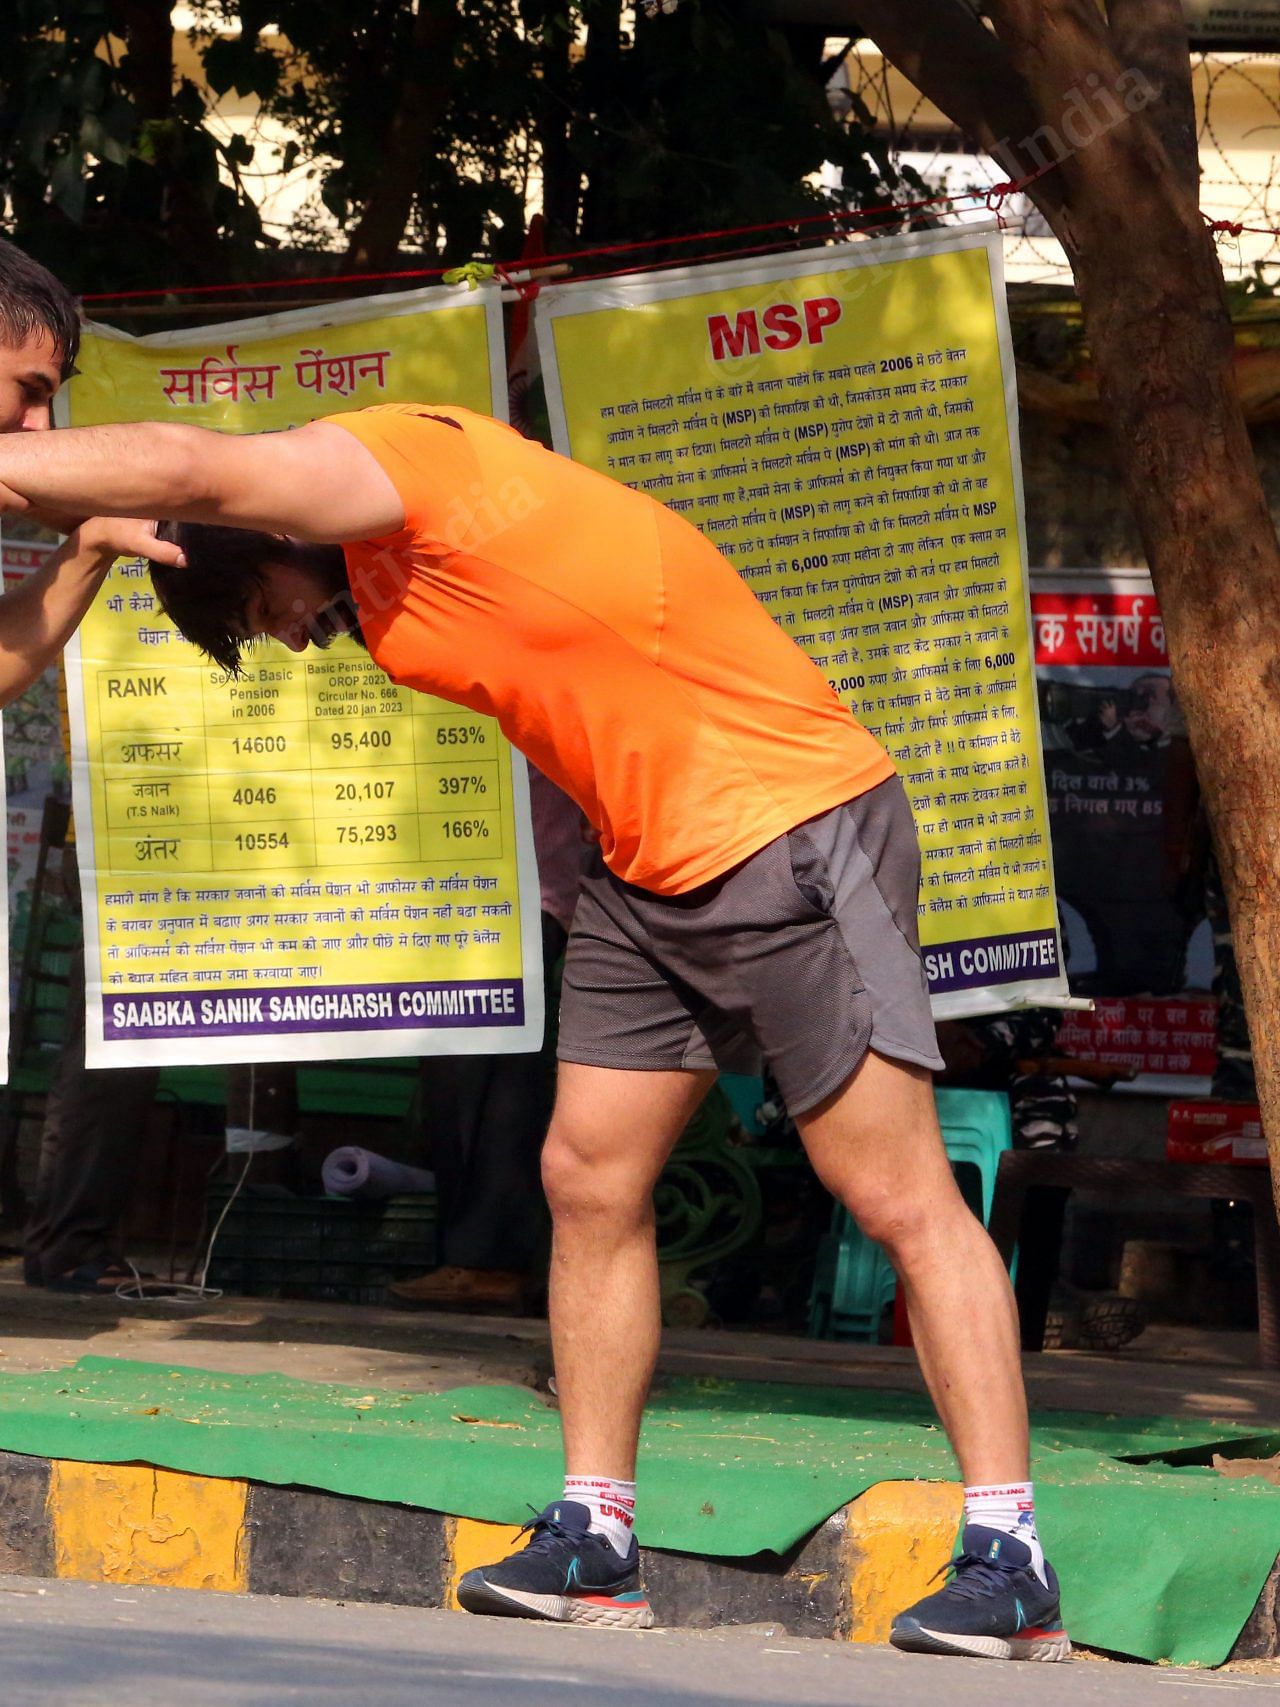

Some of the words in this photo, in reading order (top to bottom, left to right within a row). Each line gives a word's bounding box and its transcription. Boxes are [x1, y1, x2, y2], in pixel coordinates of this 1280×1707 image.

[708, 297, 841, 361] MSP
[160, 345, 280, 404] सर्विस
[295, 349, 390, 396] पेंशन
[880, 357, 912, 373] 2006
[722, 409, 756, 428] (MSP)
[794, 423, 828, 441] (MSP)
[836, 443, 870, 462] (MSP)
[781, 504, 815, 523] (MSP)
[973, 501, 996, 517] MSP
[792, 554, 828, 573] 6,000
[878, 594, 914, 614] (MSP)
[1075, 598, 1143, 654] संघर्ष
[307, 663, 334, 674] Basic
[985, 652, 1015, 671] 6,000
[210, 672, 255, 684] Seice
[260, 669, 293, 681] Basic
[329, 677, 359, 686] OROP
[363, 675, 386, 685] 2023
[829, 675, 864, 693] 2,000
[108, 677, 168, 698] RANK
[230, 689, 279, 700] Pension
[319, 691, 357, 702] Circular
[361, 690, 378, 700] No.
[381, 689, 397, 698] 666
[232, 706, 243, 718] in
[247, 704, 275, 716] 2006
[316, 705, 344, 716] Dated
[347, 704, 359, 715] 20
[380, 702, 402, 713] 2023
[331, 731, 391, 751] 95,400
[437, 726, 485, 745] 553%
[232, 736, 286, 755] 14600
[132, 783, 171, 797] जवान
[335, 782, 395, 801] 20,107
[439, 776, 486, 795] 397%
[233, 787, 276, 805] 4046
[337, 824, 397, 845] 75,293
[442, 820, 489, 838] 166%
[136, 834, 180, 861] अंतर
[235, 832, 289, 851] 10554
[196, 889, 230, 901] सरकार
[235, 885, 266, 900] जवानों
[326, 882, 350, 897] पेंशन
[960, 937, 1055, 975] COMMITTEE
[113, 1000, 195, 1028] SAABKA
[201, 997, 262, 1025] SANIK
[270, 993, 392, 1022] SANGHARSH
[399, 988, 515, 1016] COMMITTEE
